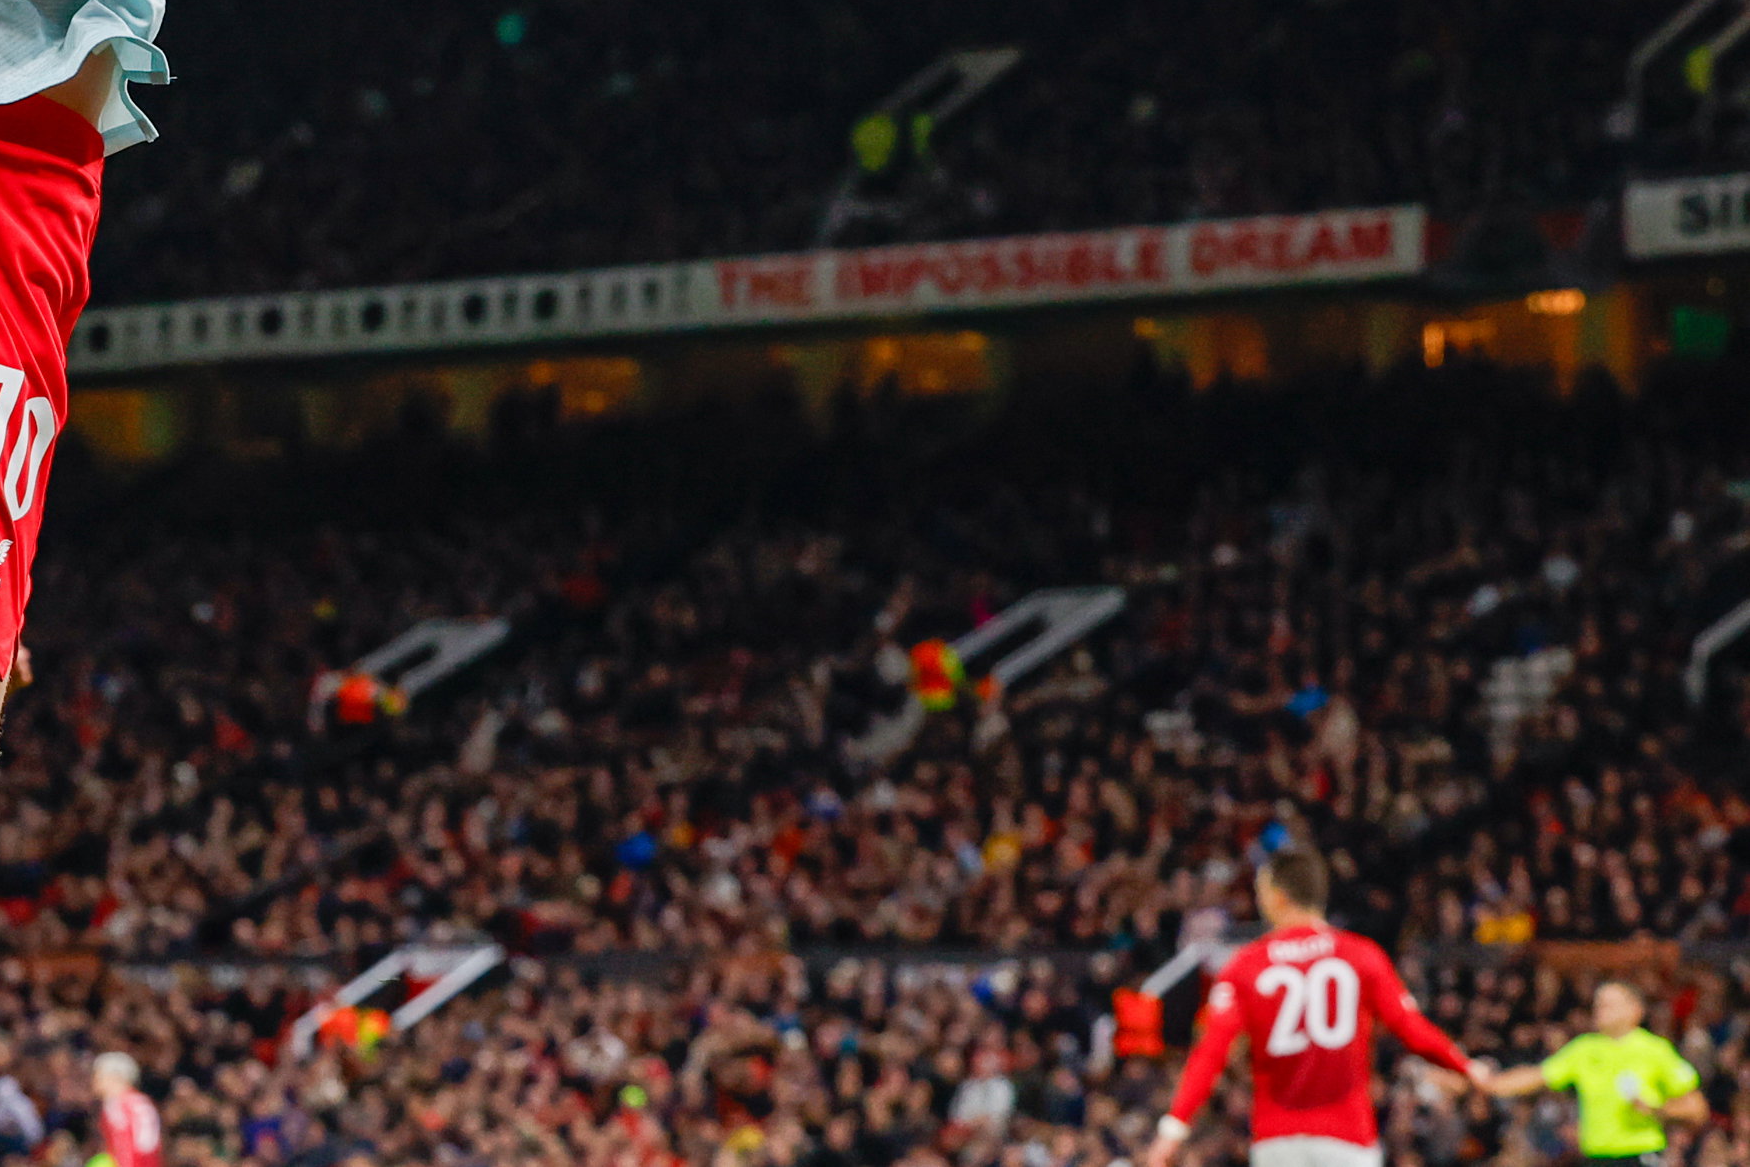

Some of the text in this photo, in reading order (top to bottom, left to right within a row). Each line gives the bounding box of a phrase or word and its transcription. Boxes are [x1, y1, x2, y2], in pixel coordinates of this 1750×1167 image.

[1677, 187, 1750, 237] SI
[716, 217, 1393, 309] THE IMPOSSIBLE DREAM
[1256, 956, 1361, 1058] 20
